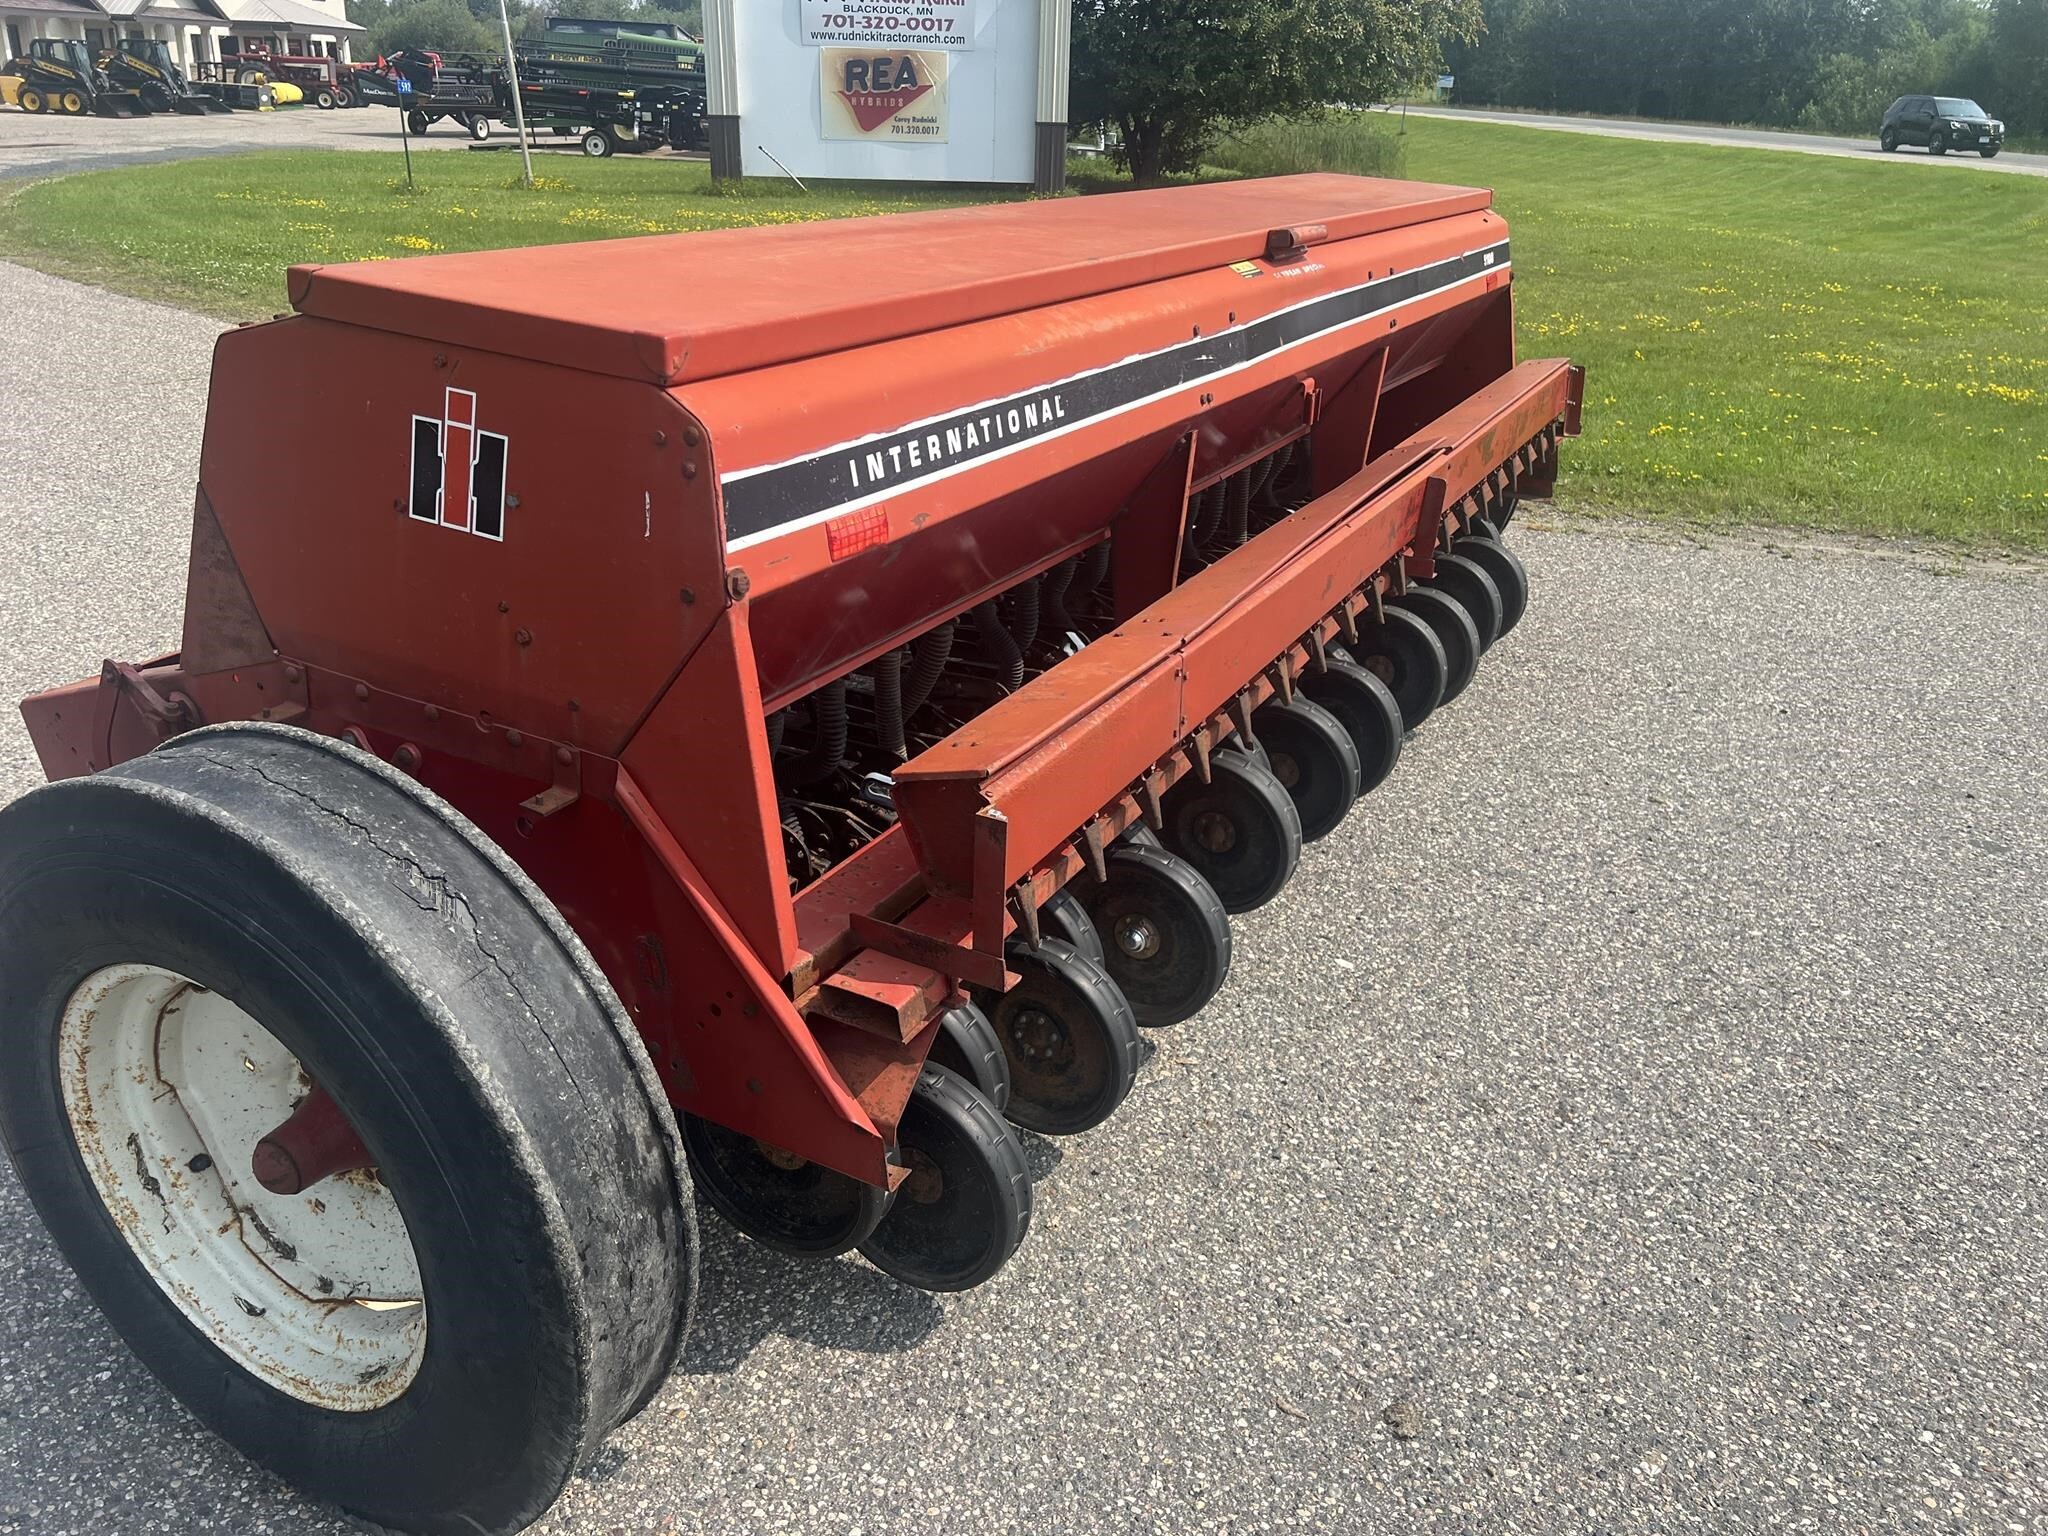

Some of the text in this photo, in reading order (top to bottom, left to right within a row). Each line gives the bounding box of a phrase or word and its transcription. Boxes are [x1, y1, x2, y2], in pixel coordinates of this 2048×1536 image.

[843, 4, 933, 16] BLACKDUCK, MN
[821, 14, 955, 32] 701-320-0017
[810, 30, 965, 45] www.rudnickitractorranch.com
[845, 55, 919, 93] REA
[851, 96, 904, 107] HYBRIDS
[891, 125, 940, 135] 701.320.0017
[849, 394, 1065, 488] INTERNATIONAL
